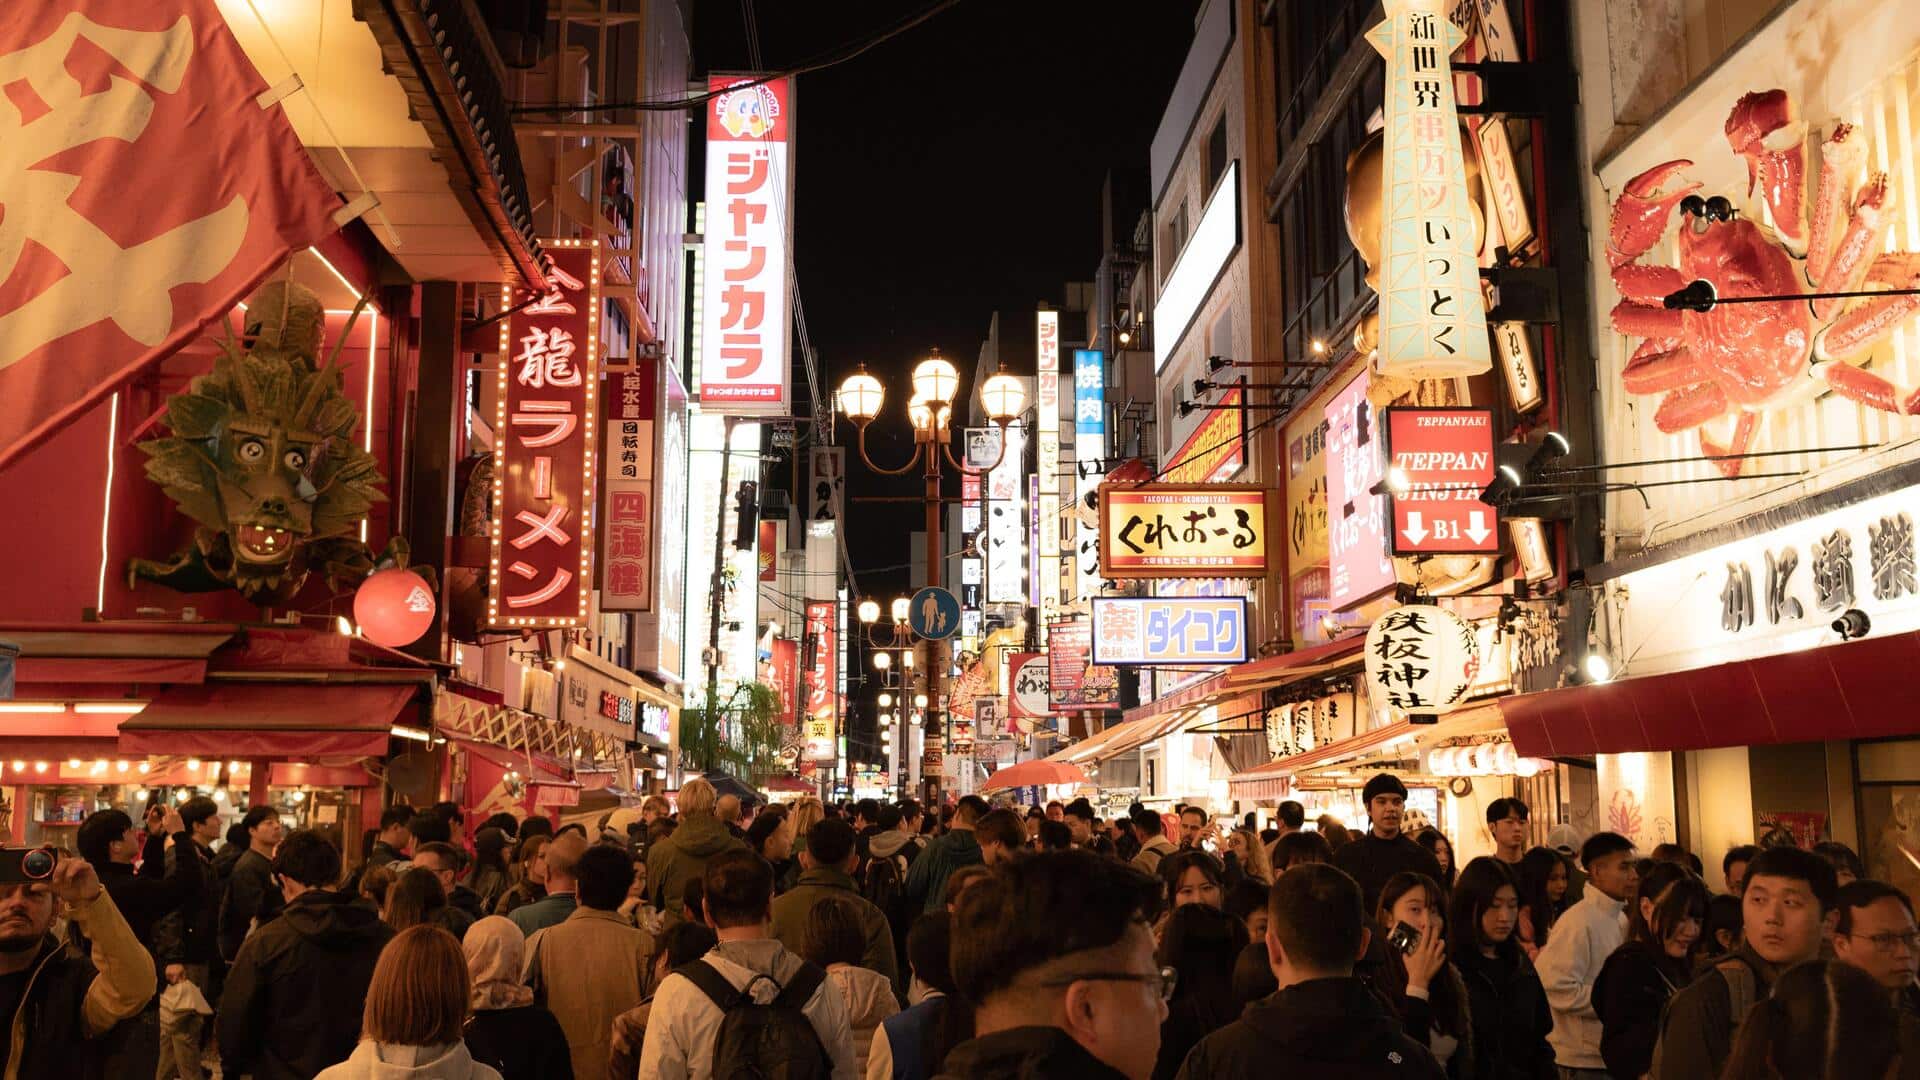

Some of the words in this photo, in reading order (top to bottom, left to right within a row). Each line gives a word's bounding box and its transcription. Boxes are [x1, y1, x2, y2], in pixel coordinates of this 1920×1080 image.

[1410, 13, 1456, 355] 新世界串カツいっとく
[720, 148, 769, 380] ジャンカラ
[1040, 321, 1057, 407] ジャンカラ
[1076, 363, 1103, 423] 焼肉
[506, 253, 585, 609] 金龍ラーメン
[1416, 416, 1488, 427] TEPPANYAKI
[621, 421, 639, 478] 回転寿司
[1396, 451, 1489, 471] TEPPAN
[1397, 481, 1481, 502] JINJYA
[1118, 506, 1257, 554] くれおーる
[1432, 519, 1461, 540] B1
[404, 585, 431, 612] 金
[1102, 601, 1137, 641] 薬
[1147, 607, 1239, 654] ダイコク
[1374, 611, 1435, 710] 鉄板神社
